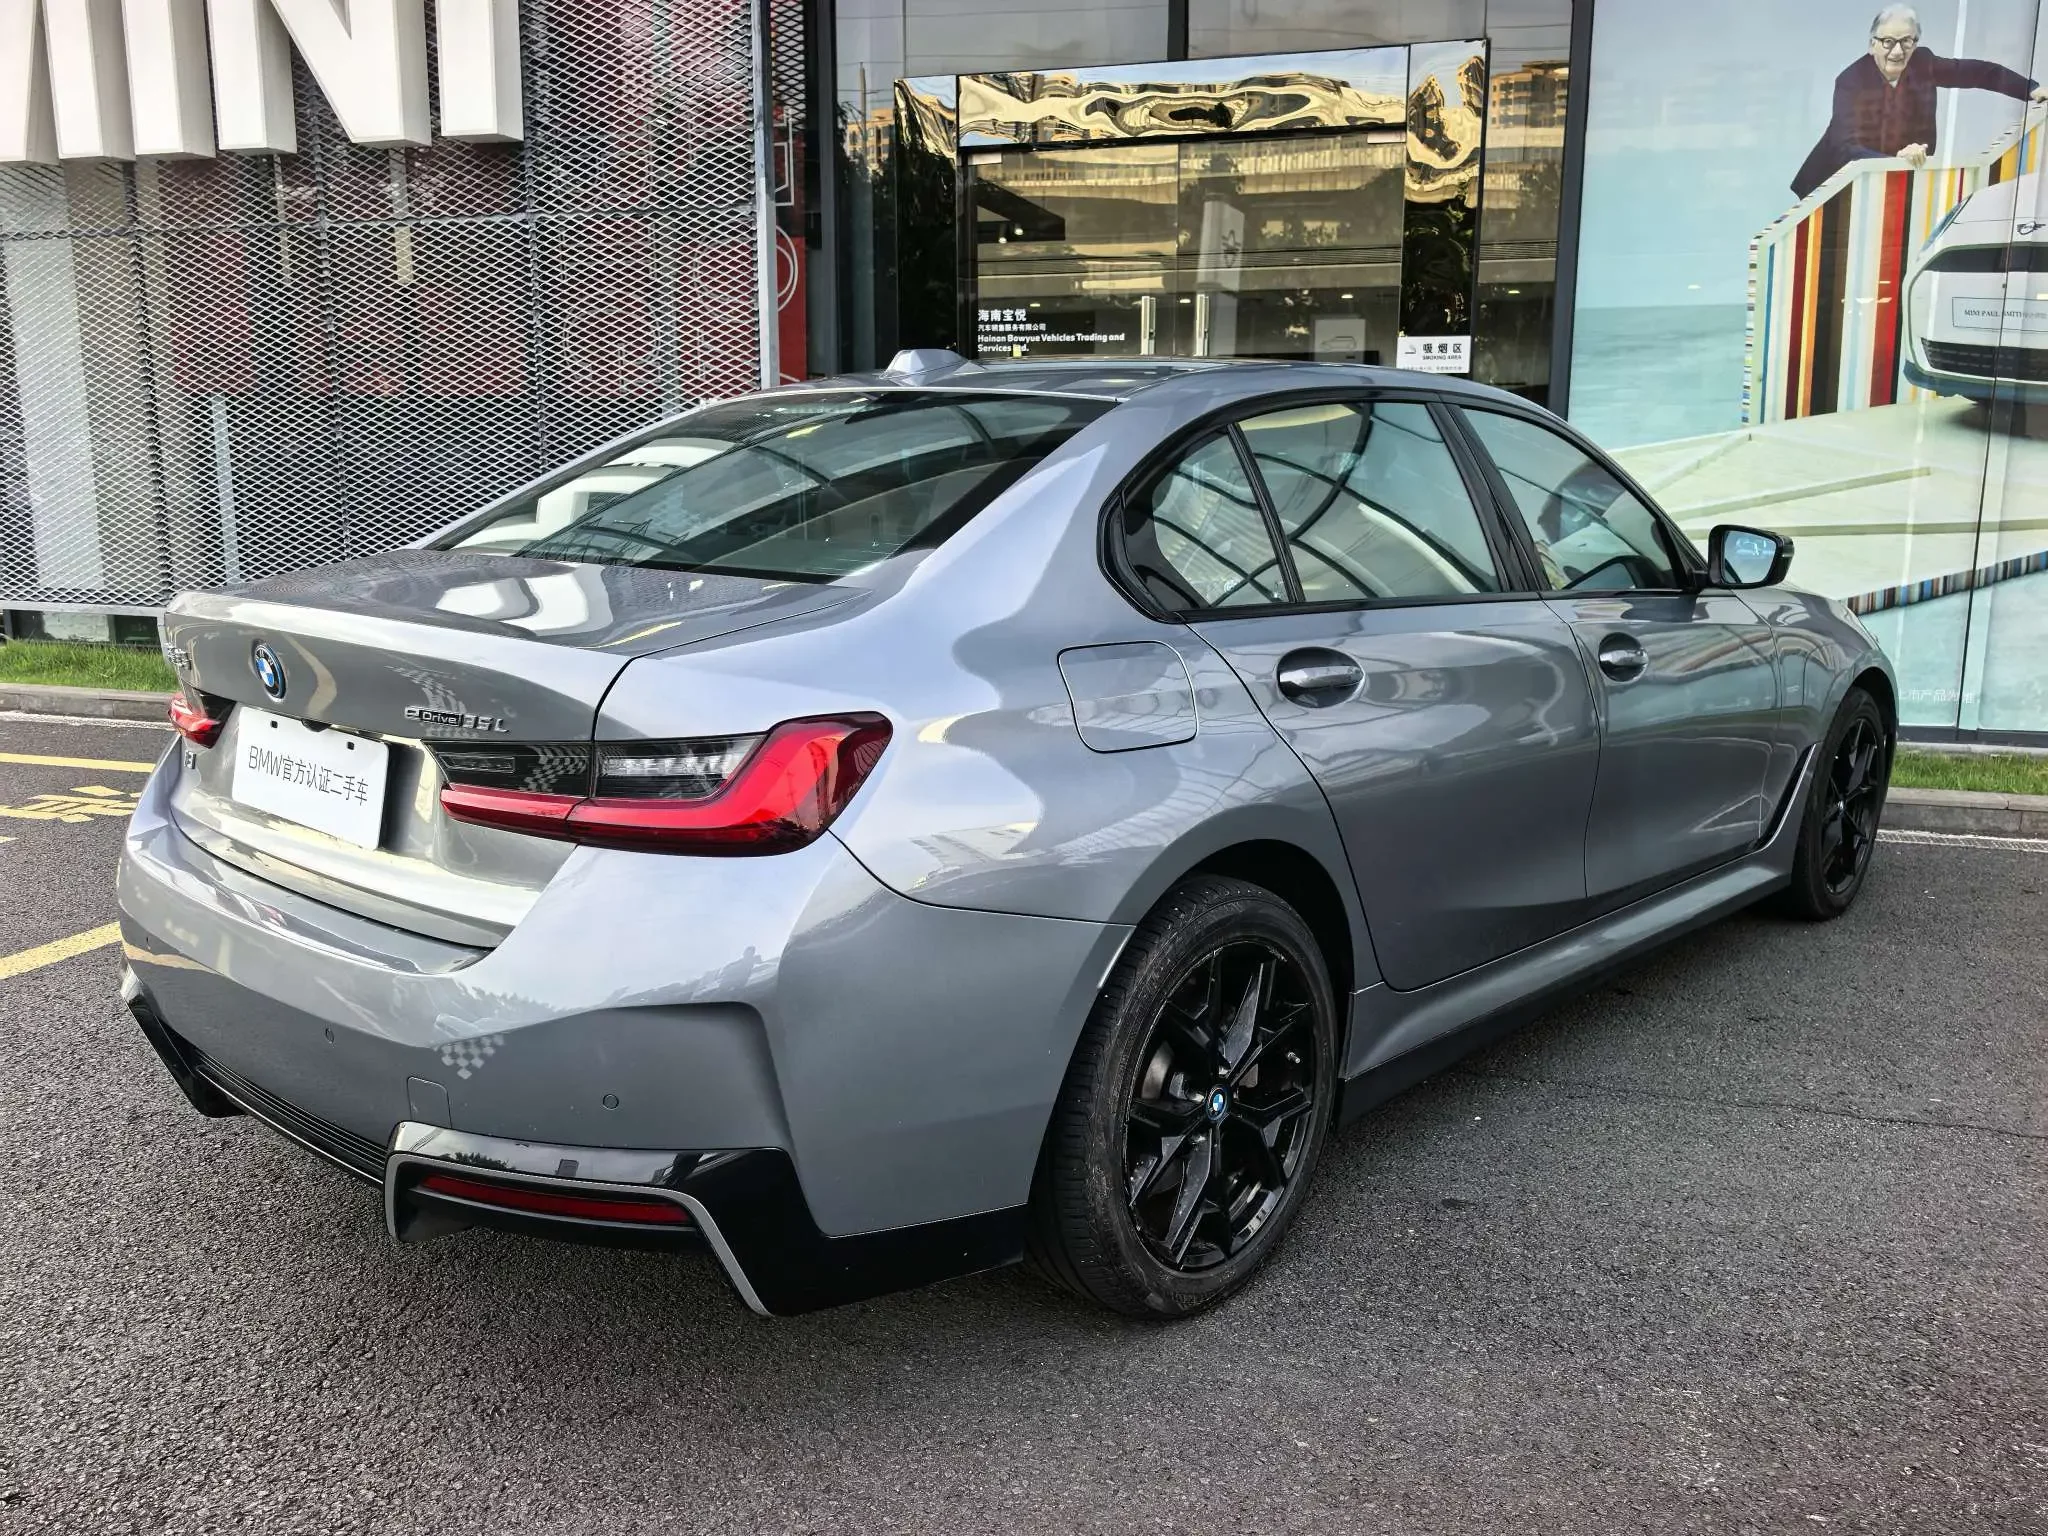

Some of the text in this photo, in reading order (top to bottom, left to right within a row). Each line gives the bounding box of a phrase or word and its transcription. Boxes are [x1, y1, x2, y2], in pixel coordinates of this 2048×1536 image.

[978, 309, 1027, 322] 海南宝悦
[978, 323, 1047, 332] 汽车销售服务有限公司
[978, 332, 1125, 344] Hainan Bowyue Vehicles Trading and
[978, 344, 1012, 353] Services
[249, 745, 369, 806] BMW官方认证二手车
